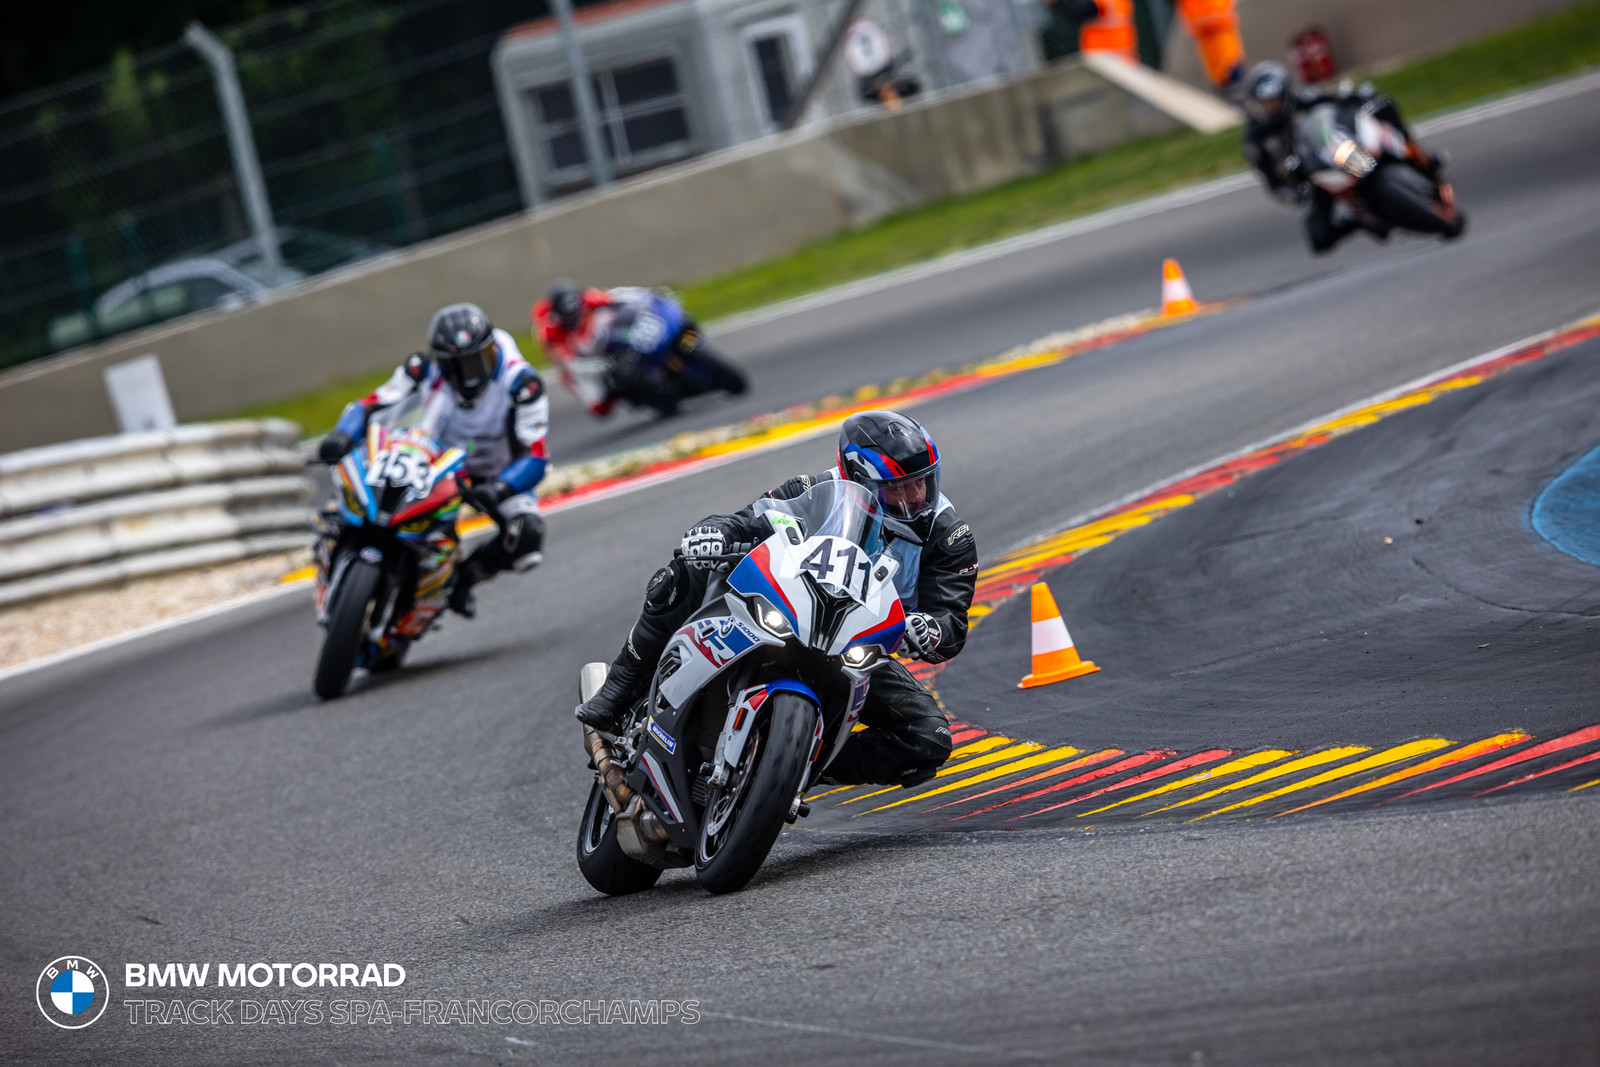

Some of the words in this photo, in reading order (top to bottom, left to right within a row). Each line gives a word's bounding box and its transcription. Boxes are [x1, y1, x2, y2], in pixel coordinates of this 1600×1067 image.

[377, 452, 430, 494] 153
[800, 538, 871, 604] 411
[736, 621, 761, 642] S1000
[652, 725, 674, 748] MICHELIN
